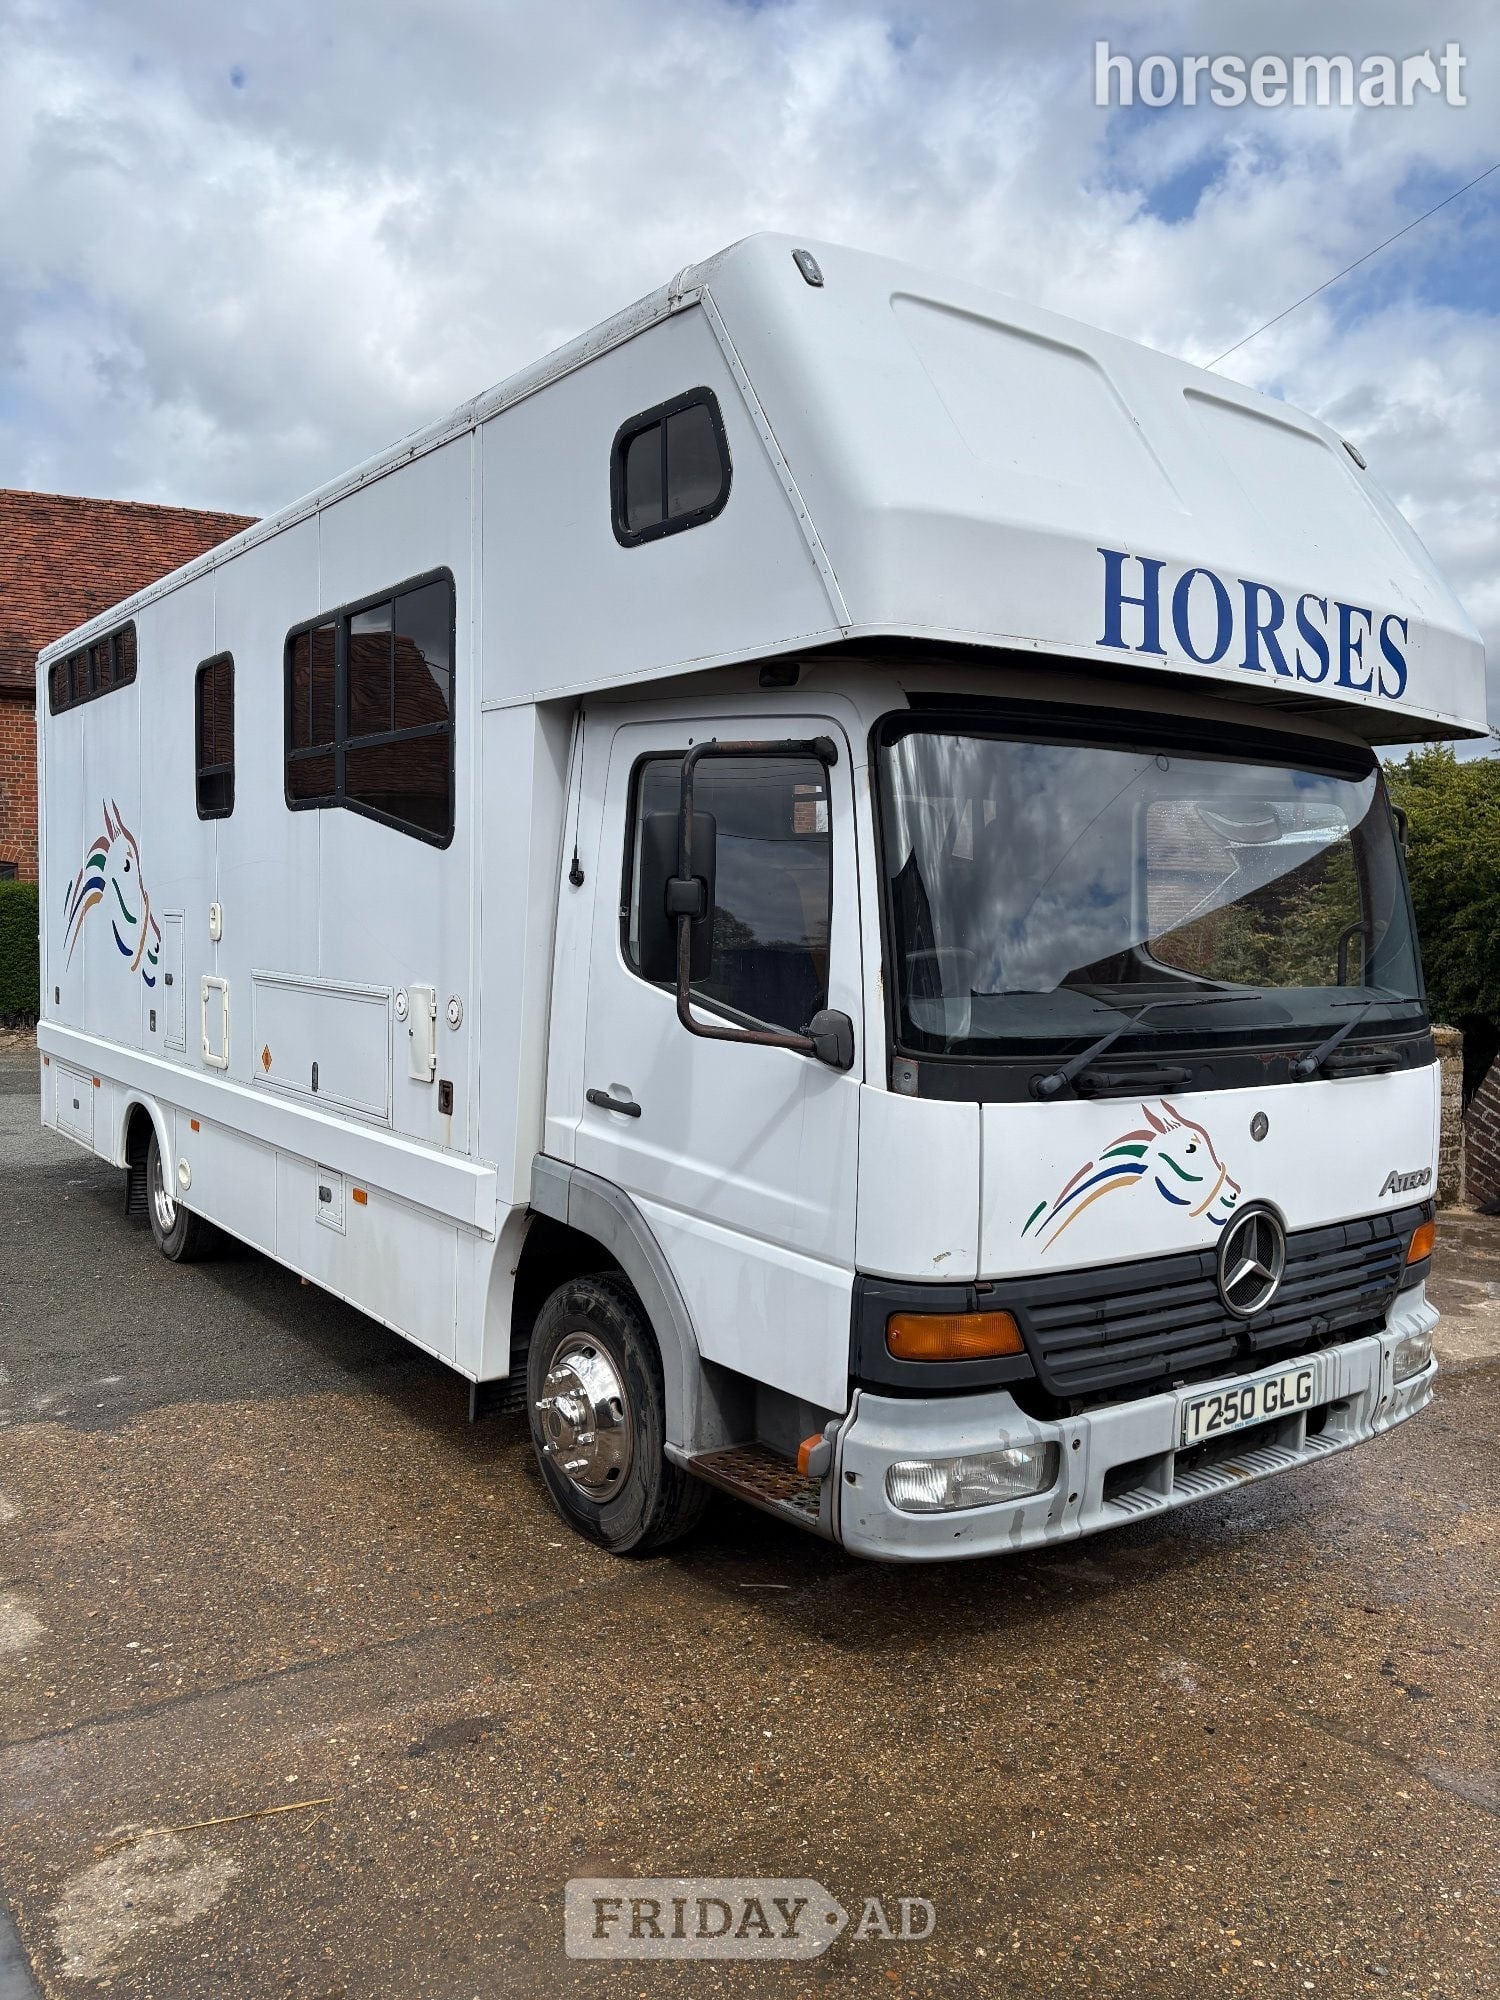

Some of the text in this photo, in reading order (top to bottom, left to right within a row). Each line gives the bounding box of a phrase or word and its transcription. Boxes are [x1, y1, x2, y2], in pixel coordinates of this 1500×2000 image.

[1096, 547, 1408, 699] HORSES
[1190, 1371, 1312, 1435] T250 GLG
